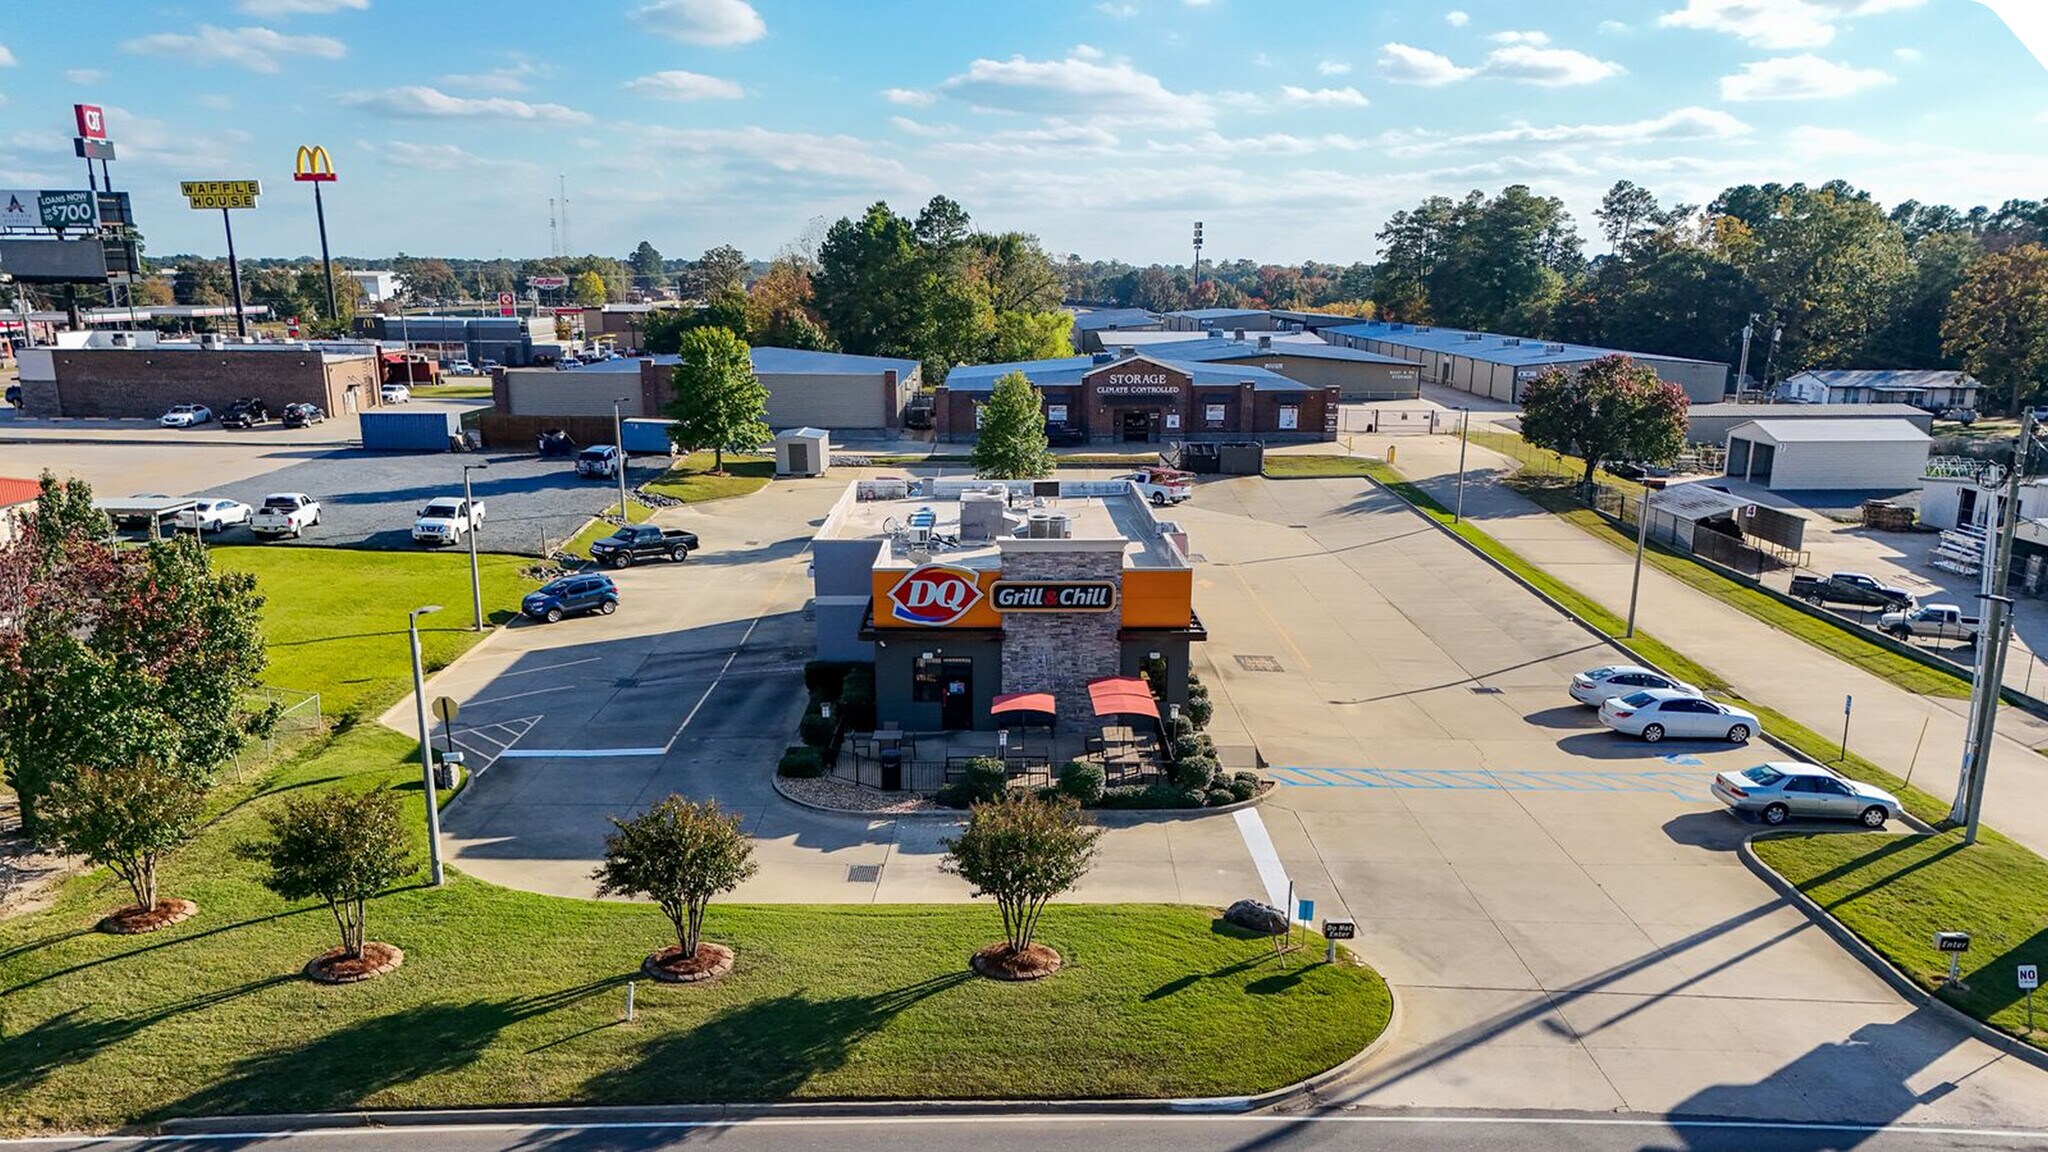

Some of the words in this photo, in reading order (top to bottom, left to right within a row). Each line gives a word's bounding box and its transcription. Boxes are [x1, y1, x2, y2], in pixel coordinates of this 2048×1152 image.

[183, 183, 257, 194] WAFFLE
[41, 195, 66, 206] LOANS
[66, 192, 88, 202] NOW
[192, 196, 252, 206] HOUSE
[52, 203, 92, 222] $700
[1109, 374, 1167, 385] STORAGE
[1096, 386, 1129, 394] CLIMATE
[1130, 386, 1180, 394] CONTROLLED
[906, 580, 966, 612] DQ
[1326, 924, 1338, 932] Do
[1339, 924, 1353, 932] Not
[1941, 940, 1967, 949] Enter
[2019, 970, 2036, 980] NO
